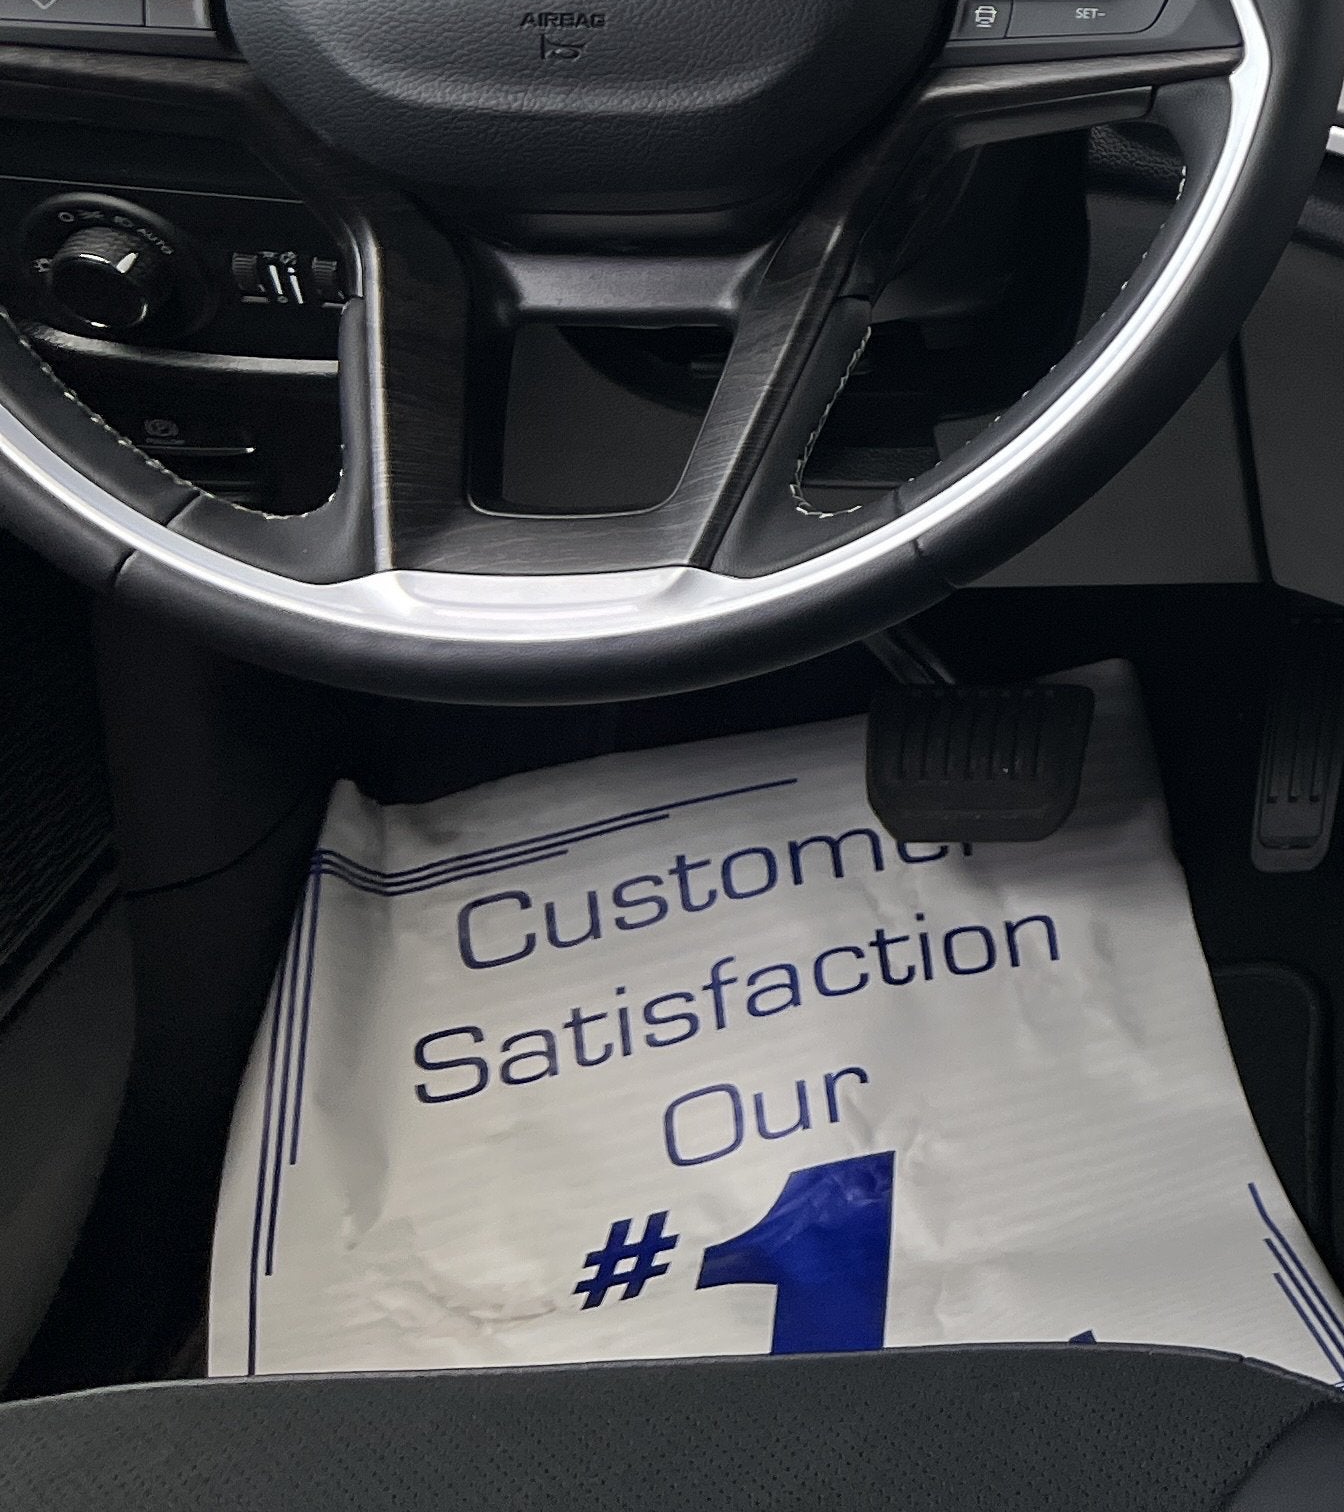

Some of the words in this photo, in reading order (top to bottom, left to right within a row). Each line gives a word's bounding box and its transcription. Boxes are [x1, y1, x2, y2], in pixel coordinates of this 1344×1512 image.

[519, 11, 606, 28] AIRBAG
[1074, 7, 1107, 20] SET-
[412, 910, 1063, 1105] Satisfaction
[663, 1063, 871, 1168] Our
[574, 1149, 897, 1356] #1
